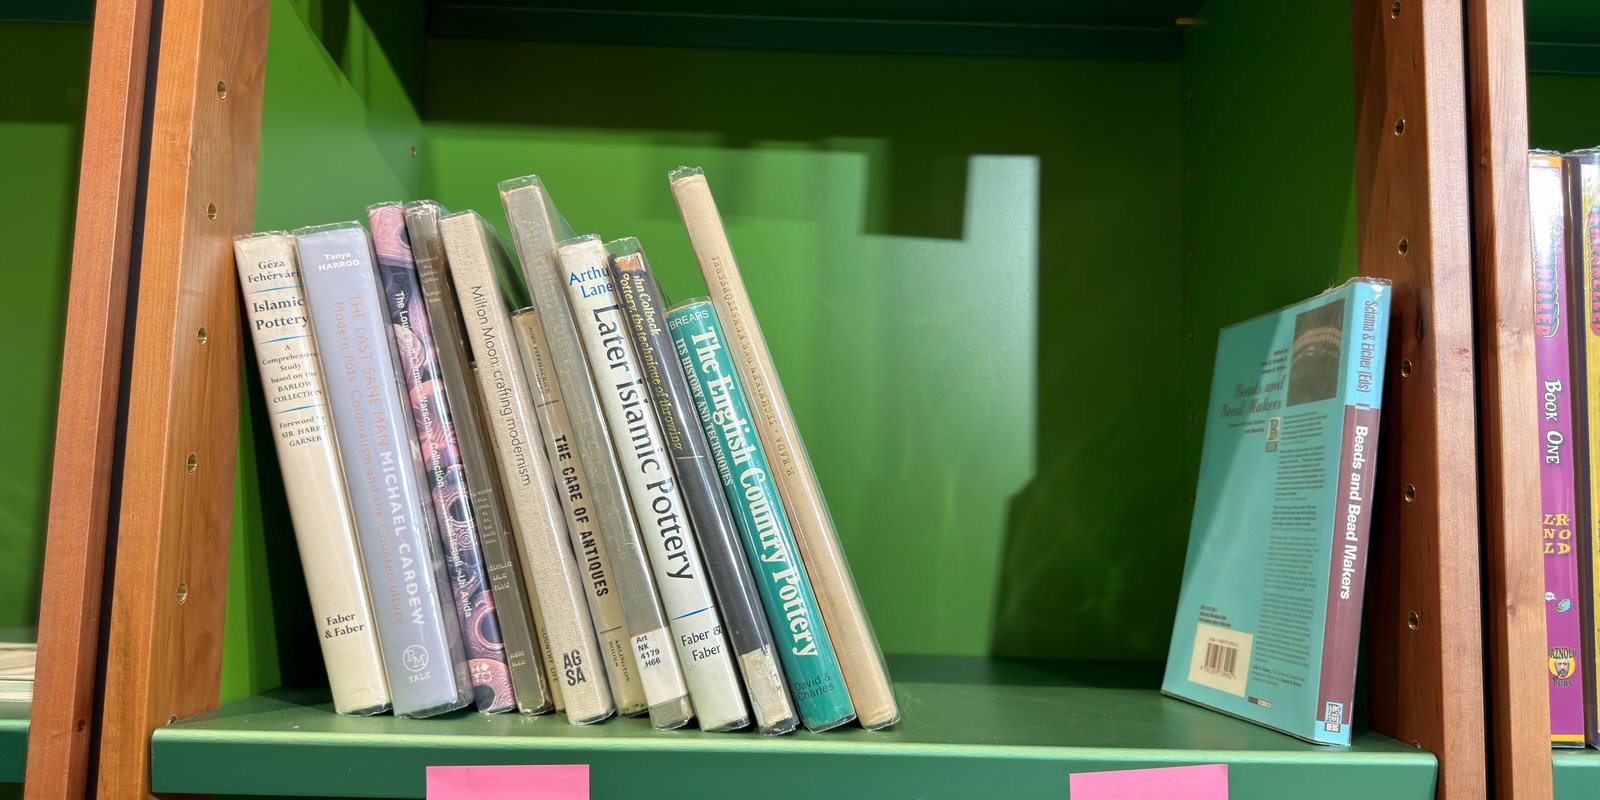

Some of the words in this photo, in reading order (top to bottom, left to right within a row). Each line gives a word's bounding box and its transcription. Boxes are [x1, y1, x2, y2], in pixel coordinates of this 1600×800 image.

[258, 259, 285, 270] Géza
[318, 258, 361, 272] HARROD
[323, 251, 351, 262] Tanya
[247, 269, 300, 283] Fehérvári
[569, 265, 610, 287] Arthu
[581, 282, 615, 299] Lane
[253, 296, 305, 313] Islamic
[349, 293, 366, 321] THE
[640, 293, 662, 336] Colbeck
[1363, 300, 1379, 332] Sciama
[255, 315, 309, 331] Pottery
[334, 301, 350, 349] Modern
[632, 313, 644, 331] the
[669, 309, 710, 331] BREARS
[355, 327, 373, 361] LAST
[1361, 333, 1376, 341] &
[262, 351, 318, 366] Comprehensive
[638, 331, 662, 385] technique
[691, 325, 722, 374] The
[1359, 343, 1376, 369] Eicher
[270, 374, 292, 384] based
[280, 363, 301, 372] Study
[277, 381, 312, 392] BARLOW
[363, 367, 382, 407] SANE
[394, 291, 406, 309] The
[428, 442, 445, 488] Collection
[470, 285, 488, 326] Milton
[482, 327, 499, 368] Moon:
[493, 369, 513, 416] crafting
[505, 418, 532, 487] modernism
[655, 386, 669, 398] of
[1234, 380, 1261, 399] Beads
[1264, 375, 1286, 393] and
[1356, 370, 1373, 393] (Eds)
[273, 389, 322, 404] COLLECTION
[750, 366, 779, 428] TECHNIKEN
[1219, 401, 1245, 417] Bead
[1248, 398, 1281, 414] Makers
[279, 415, 315, 429] Foreword
[675, 338, 688, 356] ITS
[682, 355, 701, 398] HISTORY
[696, 398, 711, 422] AND
[705, 422, 733, 487] TECHNIQUES
[706, 374, 757, 465] English
[281, 431, 294, 440] SIR
[351, 390, 373, 464] Colonialism
[372, 411, 391, 447] MAN
[660, 400, 683, 450] throwing
[289, 435, 322, 447] GARNER
[554, 434, 572, 462] THE
[592, 304, 631, 372] Later
[616, 377, 664, 474] Islamic
[646, 477, 694, 580] Pottery
[775, 437, 792, 467] RADA
[1351, 425, 1369, 470] Beads
[366, 470, 380, 493] and
[562, 466, 583, 502] CARE
[1349, 471, 1365, 499] and
[380, 451, 407, 537] MICHAEL
[371, 494, 384, 519] the
[573, 507, 590, 524] OF
[739, 466, 787, 565] Country
[1345, 503, 1362, 542] Bead
[377, 523, 405, 625] Counterculture
[579, 530, 609, 598] ANTIQUES
[1340, 544, 1357, 600] Makers
[398, 542, 426, 626] CARDEW
[326, 611, 356, 628] Faber
[772, 563, 819, 658] Pottery
[324, 629, 334, 640] &
[334, 622, 365, 638] Faber
[636, 634, 648, 644] Art
[681, 630, 711, 647] Faber
[713, 625, 723, 636] &
[608, 640, 619, 667] BOOKS
[638, 642, 650, 652] NK
[640, 648, 660, 660] 4179
[692, 644, 722, 661] Faber
[563, 649, 582, 669] AG
[614, 639, 631, 682] ARLINGTON
[407, 671, 431, 683] YALE
[565, 667, 586, 686] SA
[793, 674, 821, 691] David
[824, 672, 832, 681] &
[1553, 680, 1573, 688] PUBS
[797, 683, 834, 701] Charles
